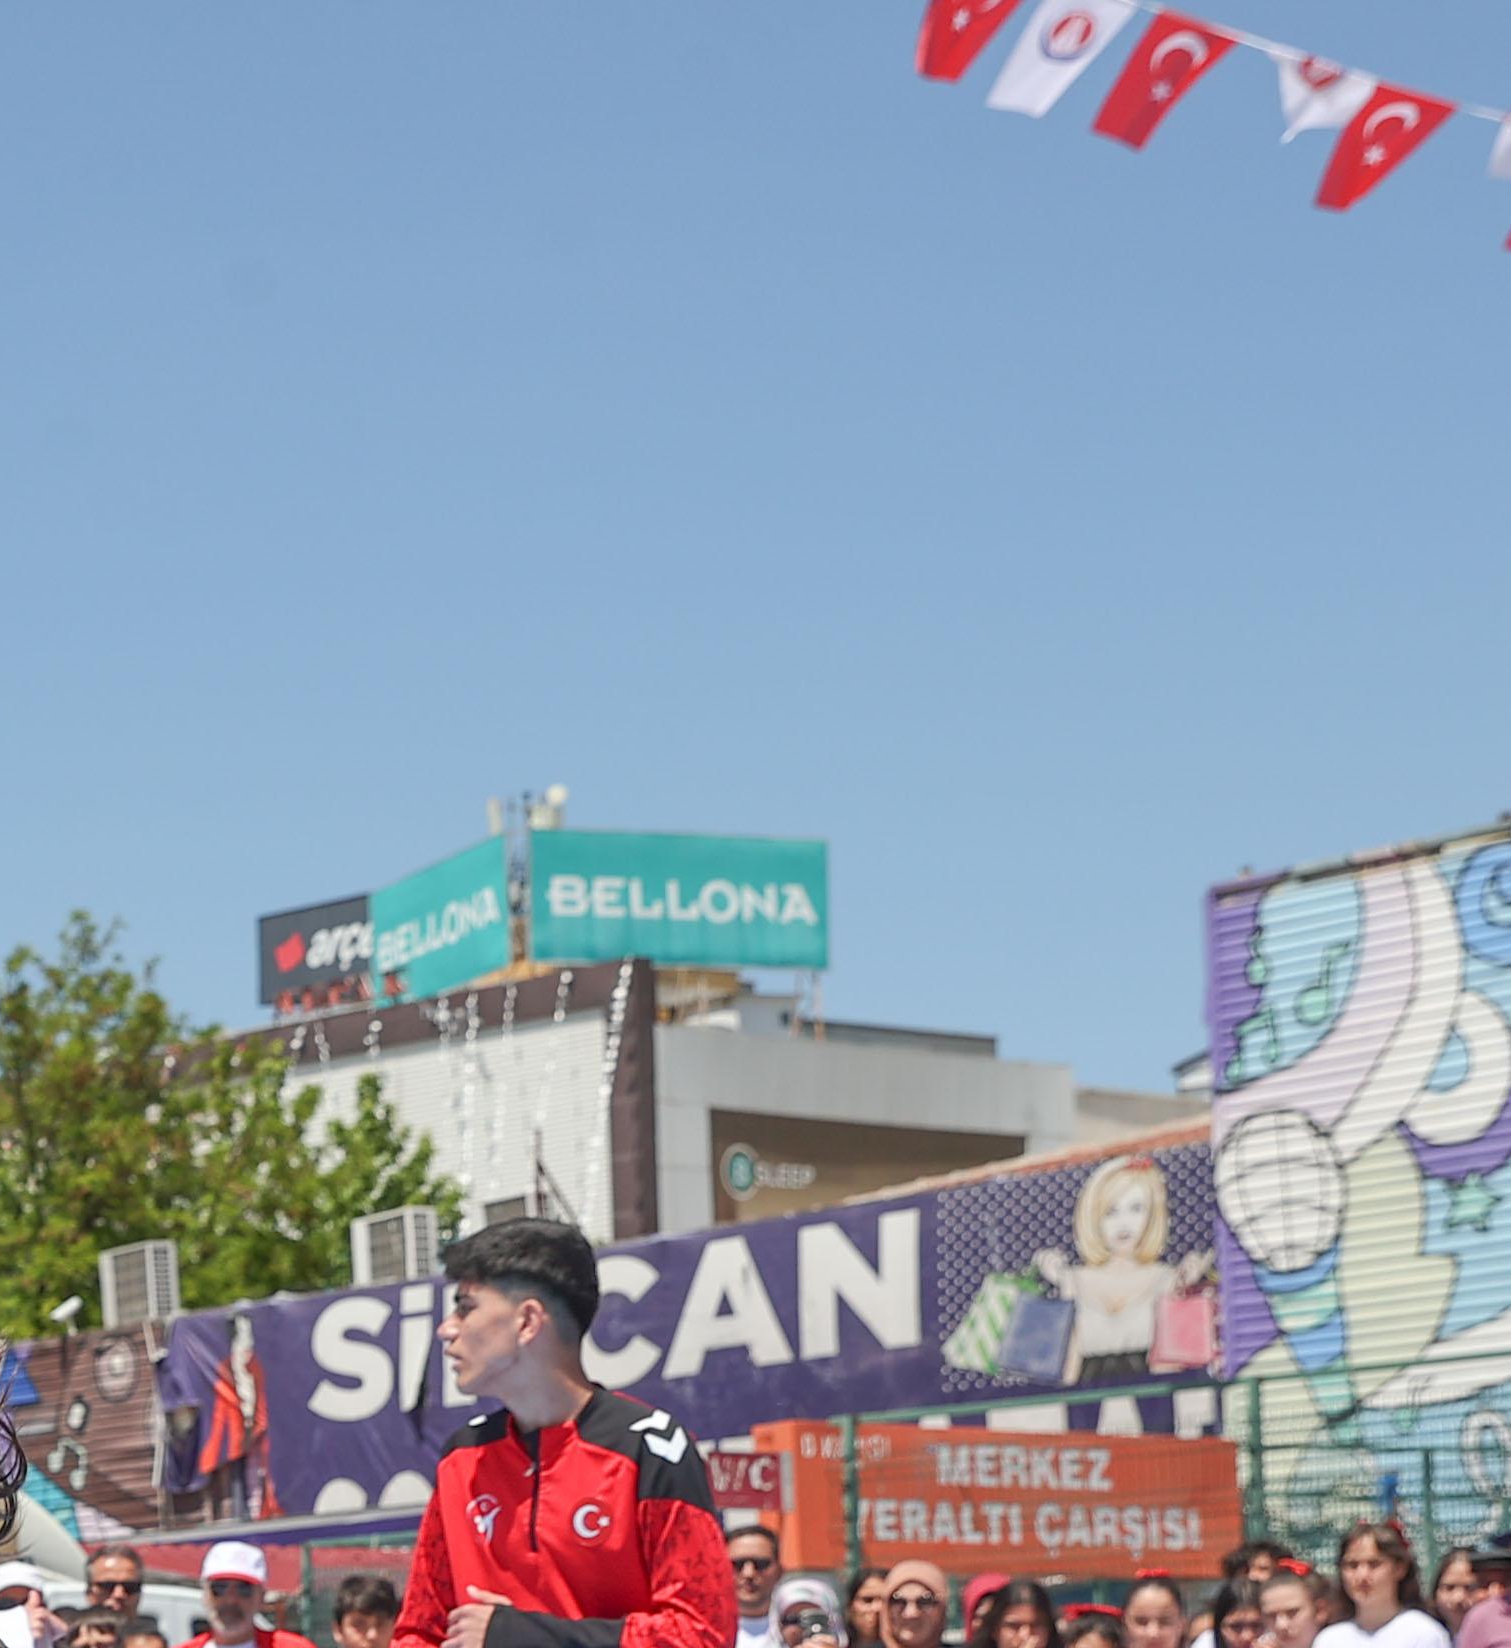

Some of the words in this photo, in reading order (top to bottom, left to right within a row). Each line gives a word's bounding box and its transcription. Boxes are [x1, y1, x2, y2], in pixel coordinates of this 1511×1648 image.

[547, 873, 819, 926] BELLONA
[376, 885, 502, 973] BELLONA
[934, 1443, 1115, 1492] MERKEZ
[1033, 1502, 1203, 1561] ÇARŞISI
